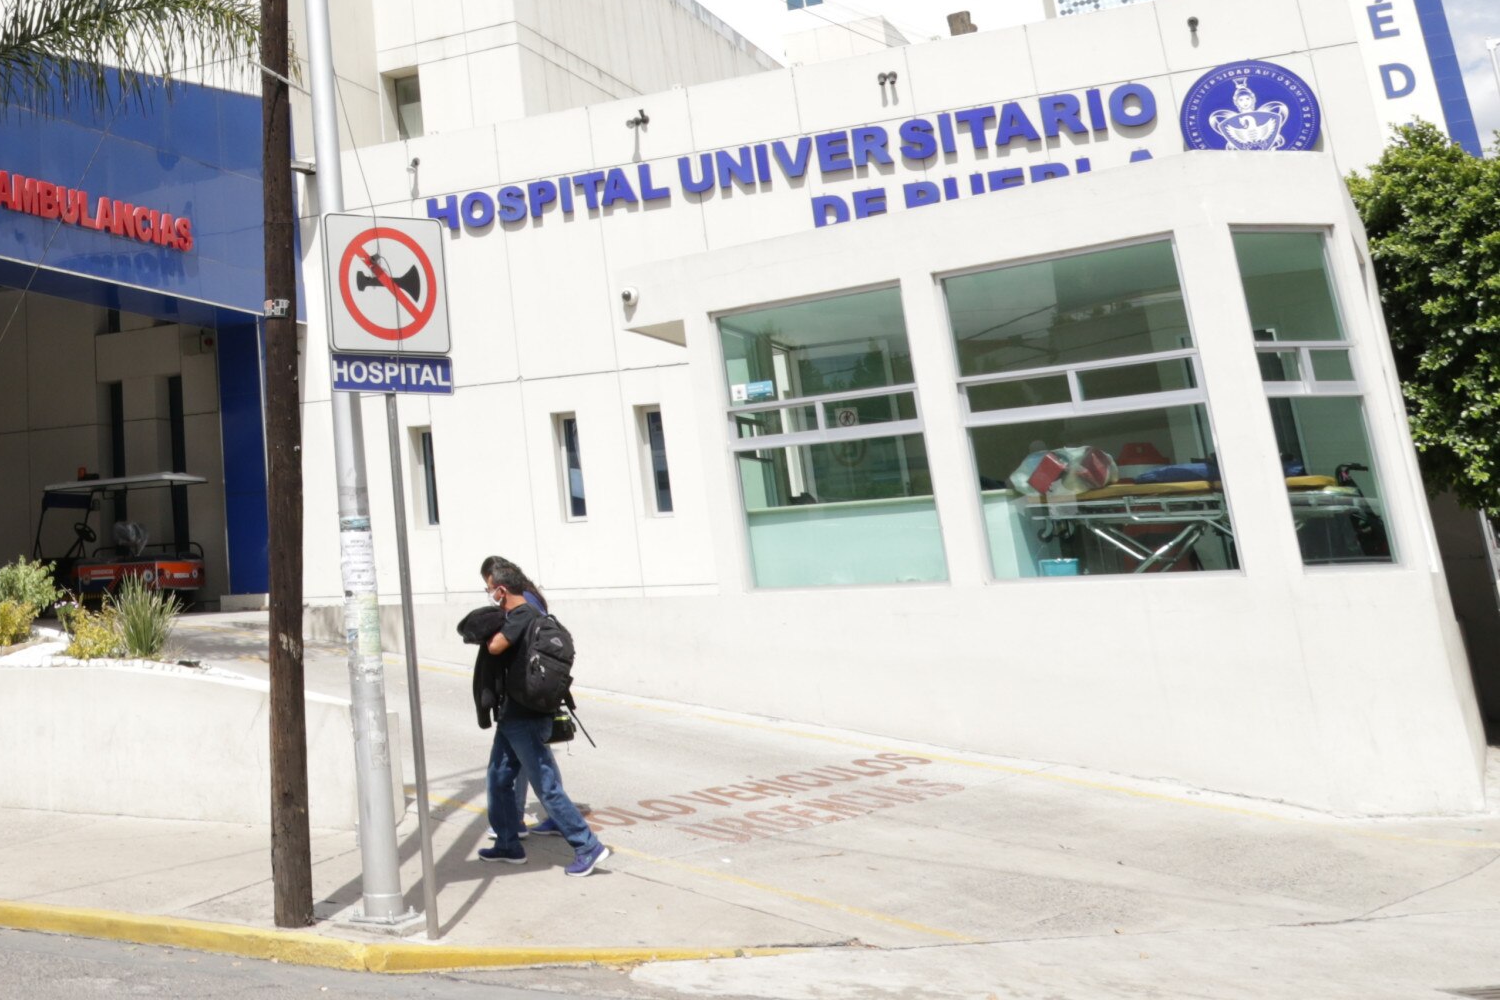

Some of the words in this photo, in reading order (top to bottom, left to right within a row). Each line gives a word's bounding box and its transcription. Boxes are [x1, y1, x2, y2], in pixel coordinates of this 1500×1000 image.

[1189, 68, 1251, 110] UNIVERSIDAD
[426, 163, 671, 231] HOSPITAL
[677, 83, 1157, 193] UNIVERSITARIO
[332, 360, 451, 387] HOSPITAL
[672, 752, 933, 810] VEHÍCULOS
[677, 777, 966, 844] URGENCIAS
